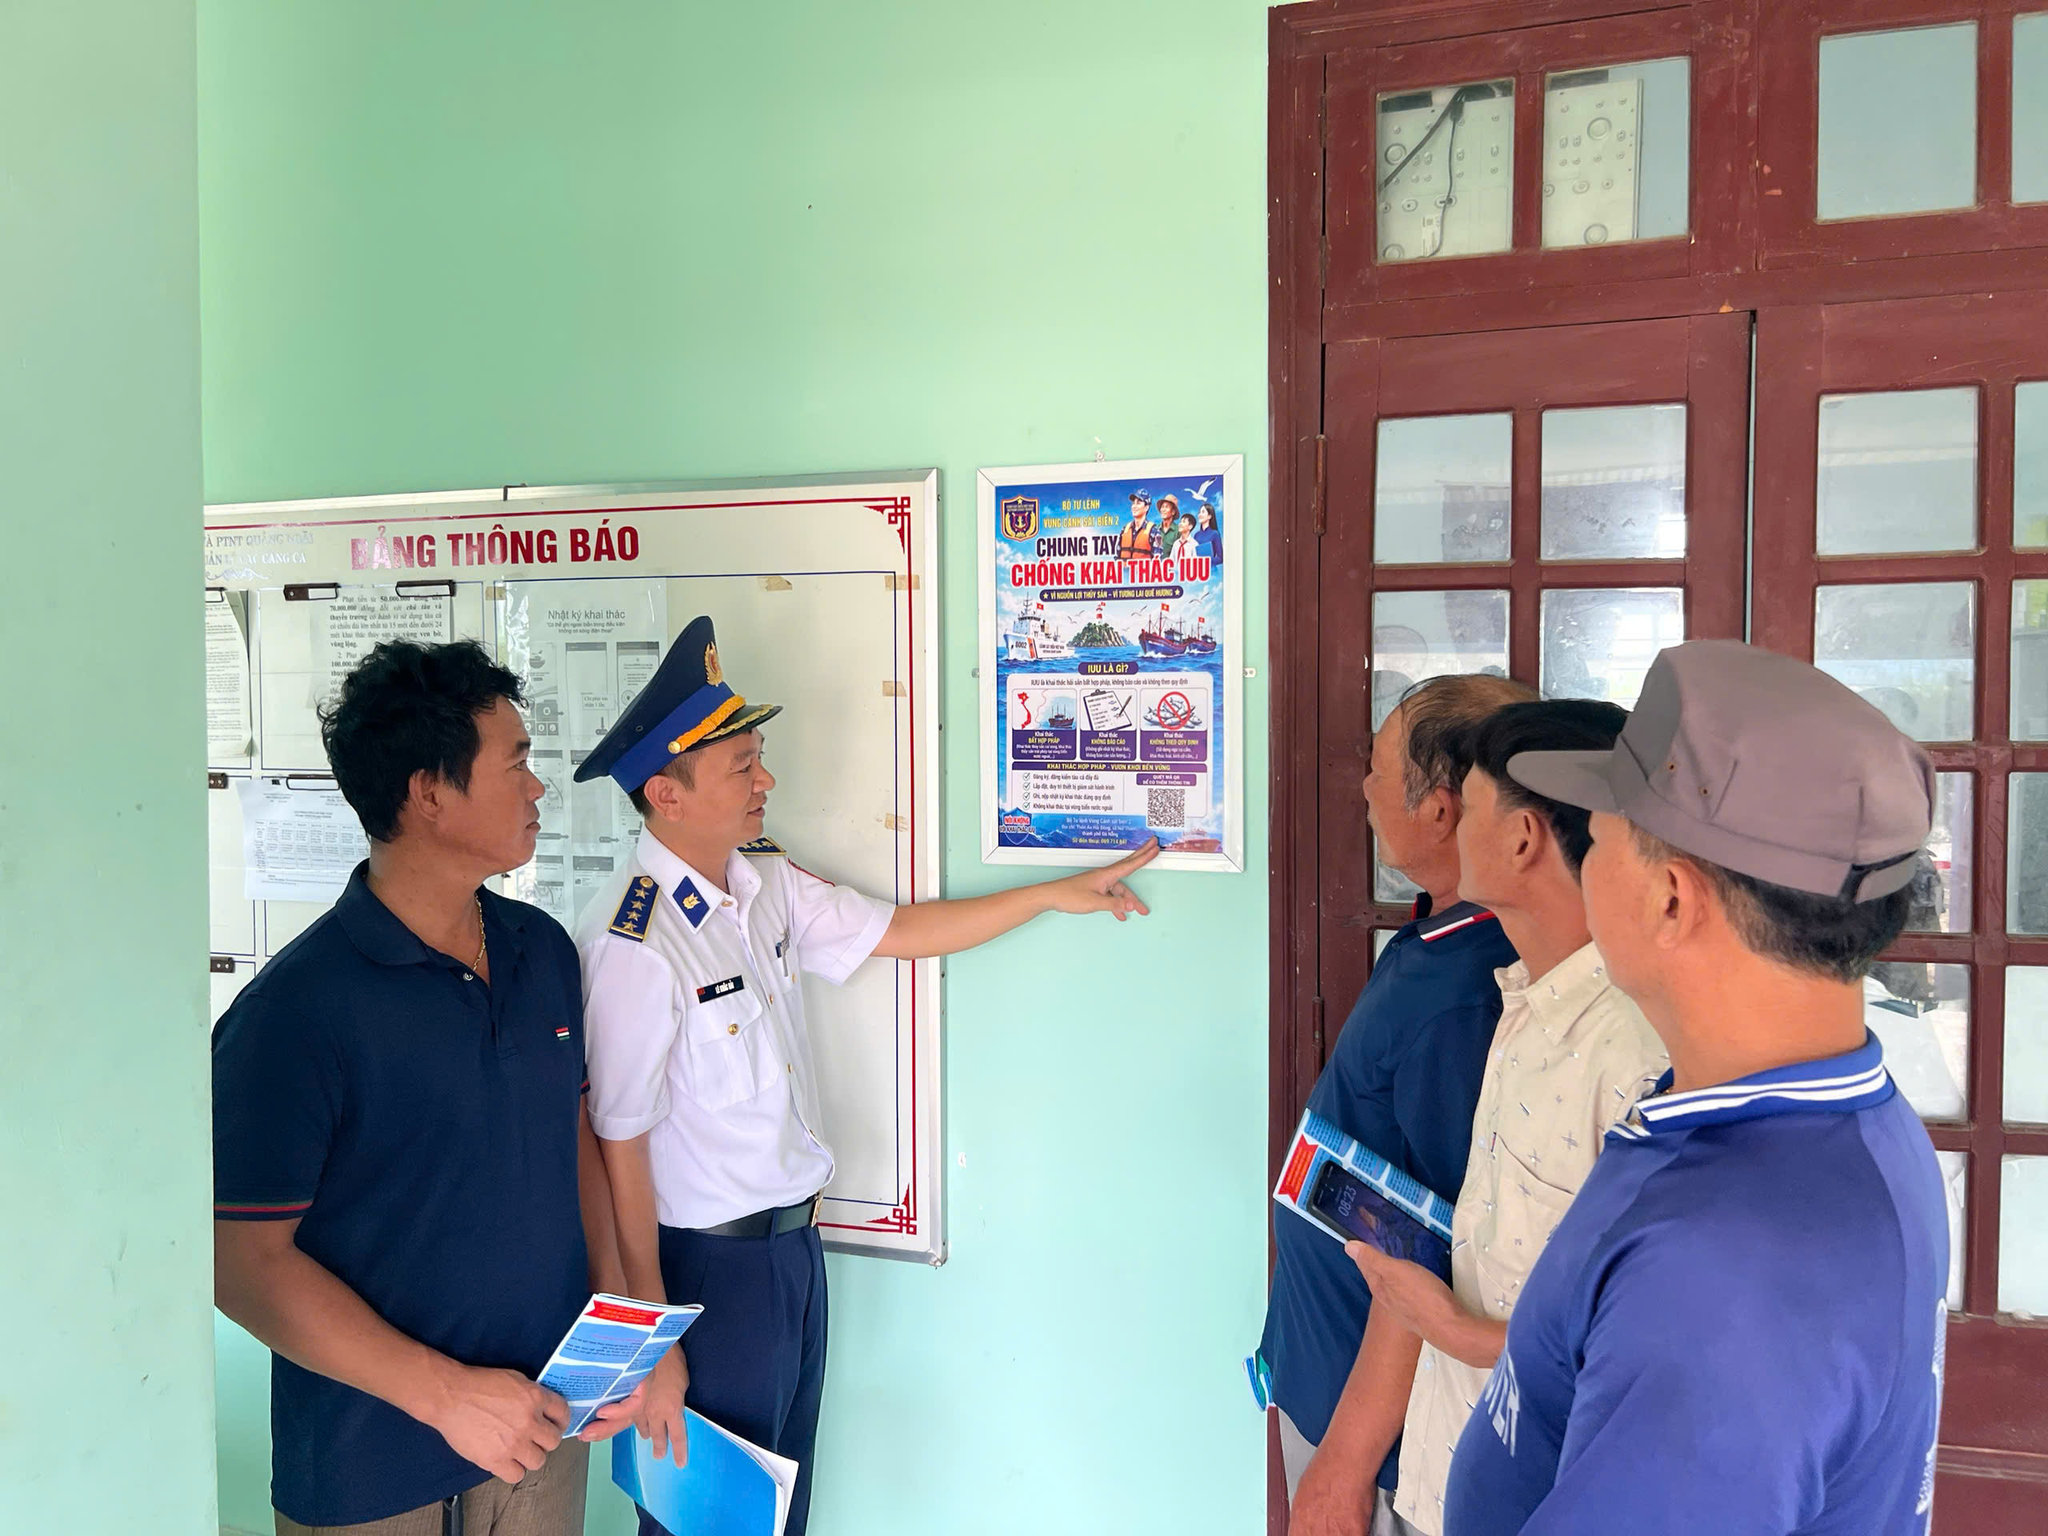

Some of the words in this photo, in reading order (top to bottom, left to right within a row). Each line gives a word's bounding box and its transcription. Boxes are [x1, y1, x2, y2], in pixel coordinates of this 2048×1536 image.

[216, 536, 243, 547] PTNT
[246, 531, 284, 546] QUẢNG
[351, 525, 436, 570] BẢNG
[447, 523, 557, 567] THÔNG
[570, 519, 639, 563] BÁO
[1036, 537, 1088, 557] CHUNG
[1092, 535, 1119, 555] TAY
[1011, 559, 1075, 587] CHỐNG
[1080, 560, 1122, 585] KHAI
[1128, 556, 1174, 583] THÁC
[1179, 558, 1211, 582] IUU
[548, 609, 569, 621] Nhật
[571, 609, 582, 621] ký
[584, 609, 604, 619] khai
[605, 609, 626, 619] thác
[1087, 664, 1101, 674] IUU
[1103, 663, 1114, 674] LÀ
[1115, 662, 1129, 674] GÌ?
[1338, 1185, 1357, 1217] 08:23
